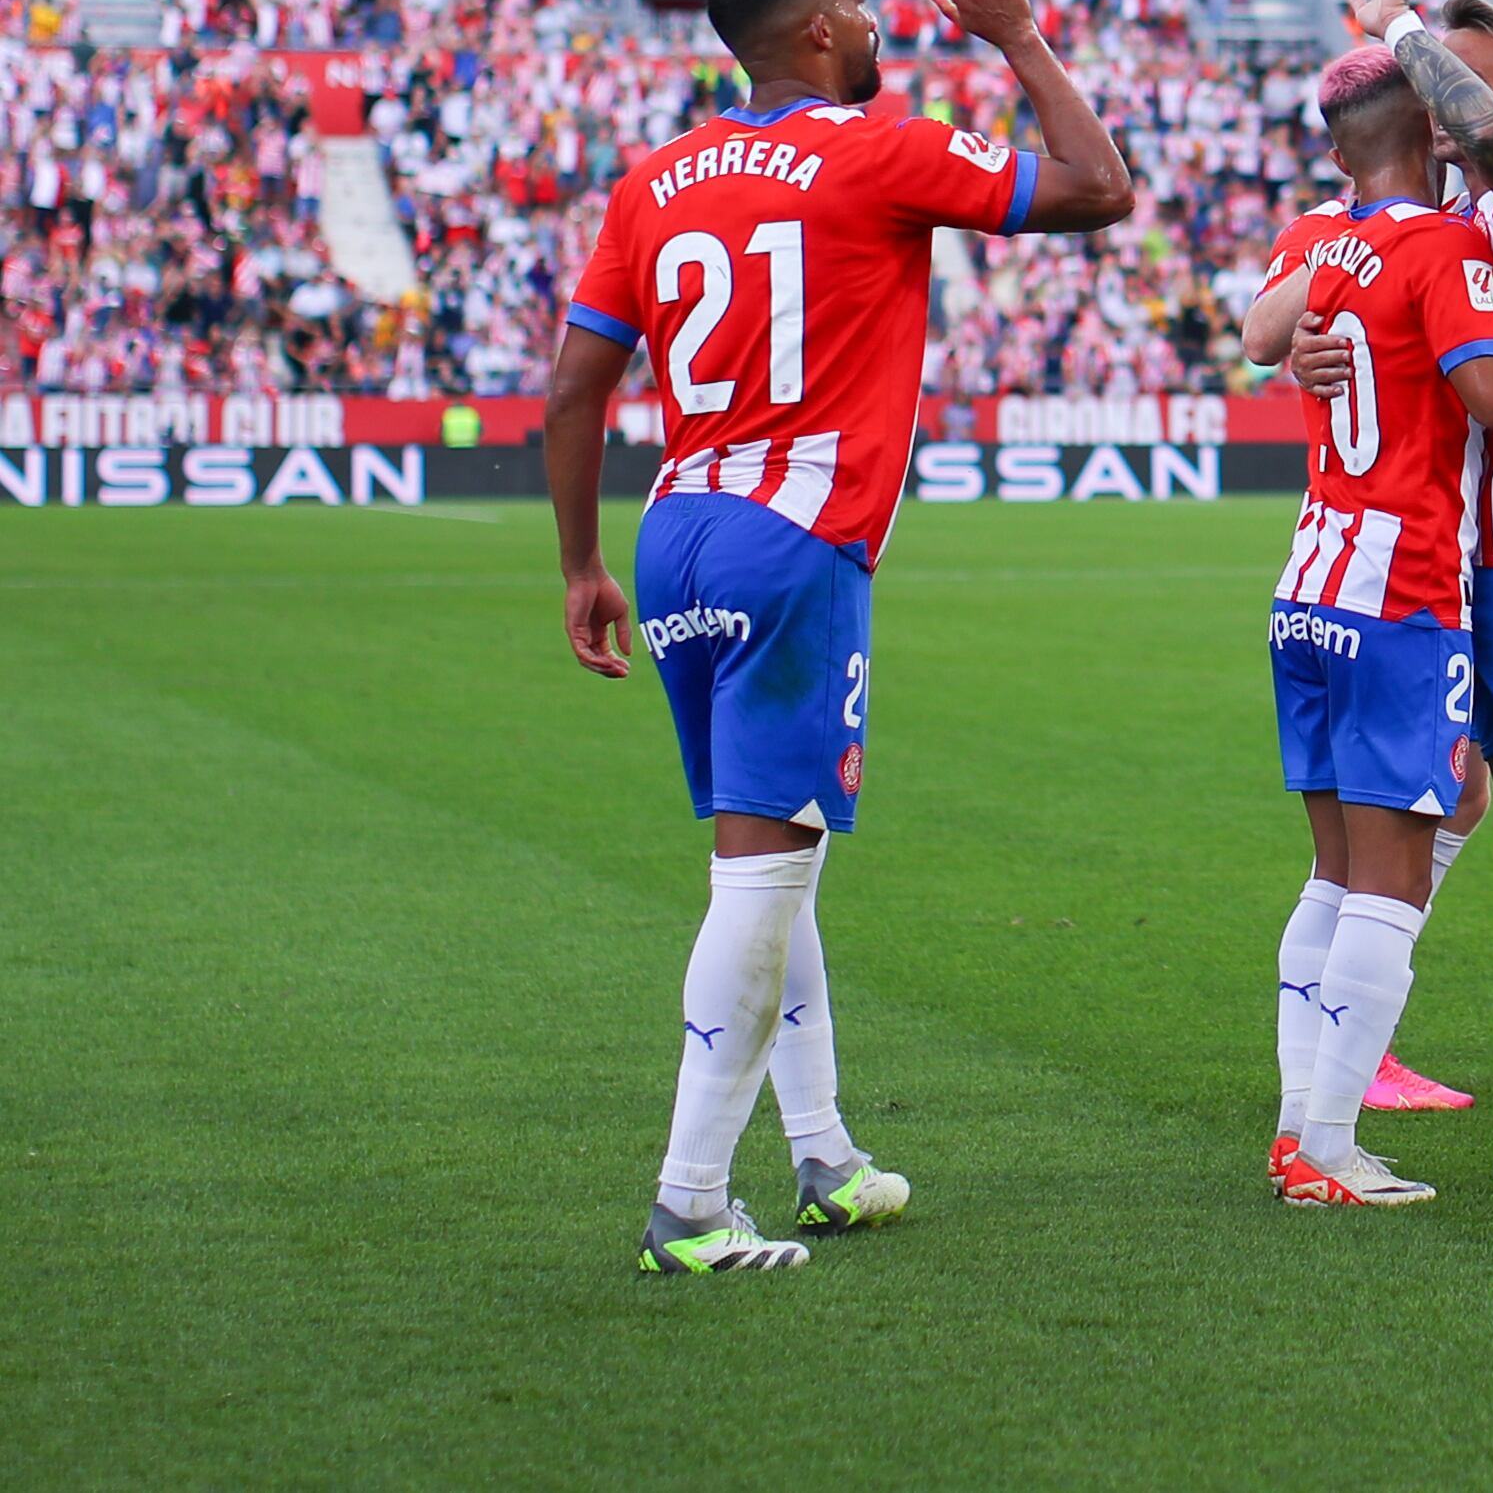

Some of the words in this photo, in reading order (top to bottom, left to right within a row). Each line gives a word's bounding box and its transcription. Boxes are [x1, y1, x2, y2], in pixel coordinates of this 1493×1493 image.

[649, 139, 823, 209] HERRERA
[655, 220, 804, 416] 21
[1169, 395, 1227, 444] FC
[843, 651, 869, 730] 2
[1446, 652, 1474, 724] 2
